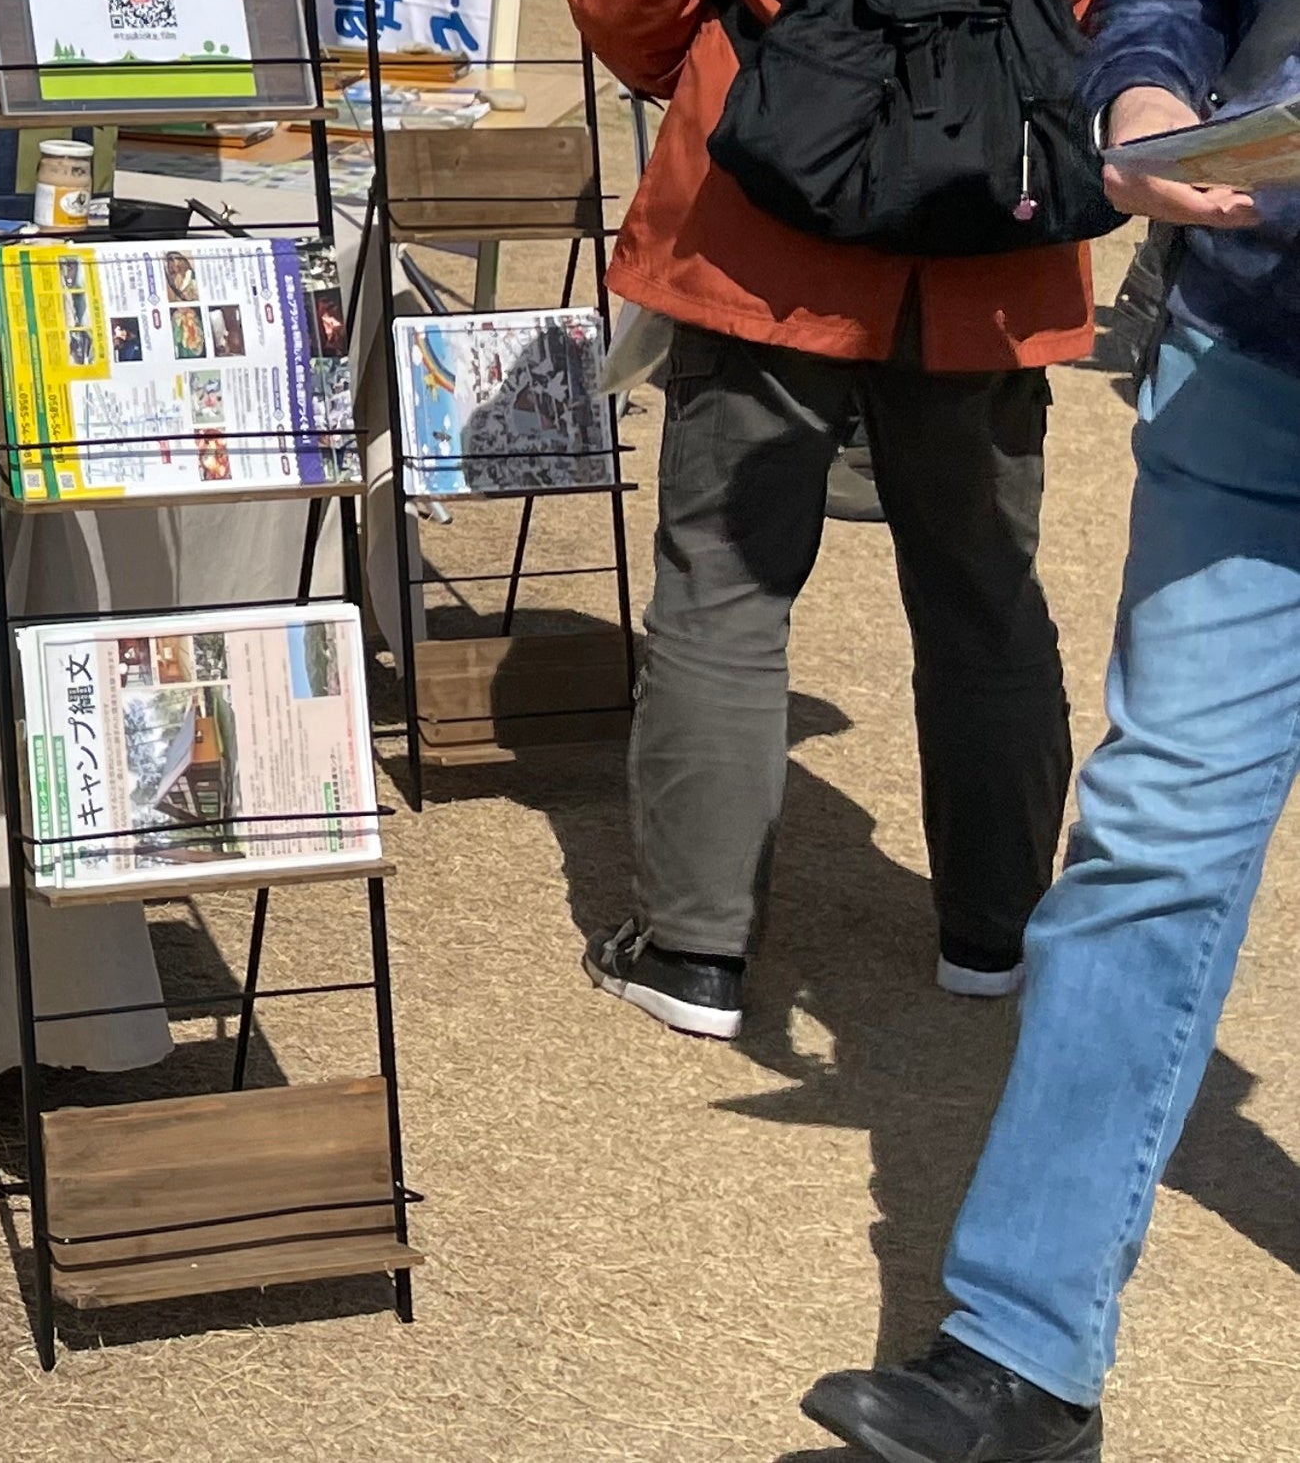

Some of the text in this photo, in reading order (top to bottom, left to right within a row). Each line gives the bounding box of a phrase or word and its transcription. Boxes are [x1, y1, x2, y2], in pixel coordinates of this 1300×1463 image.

[65, 652, 104, 828] キャンプ縄文
